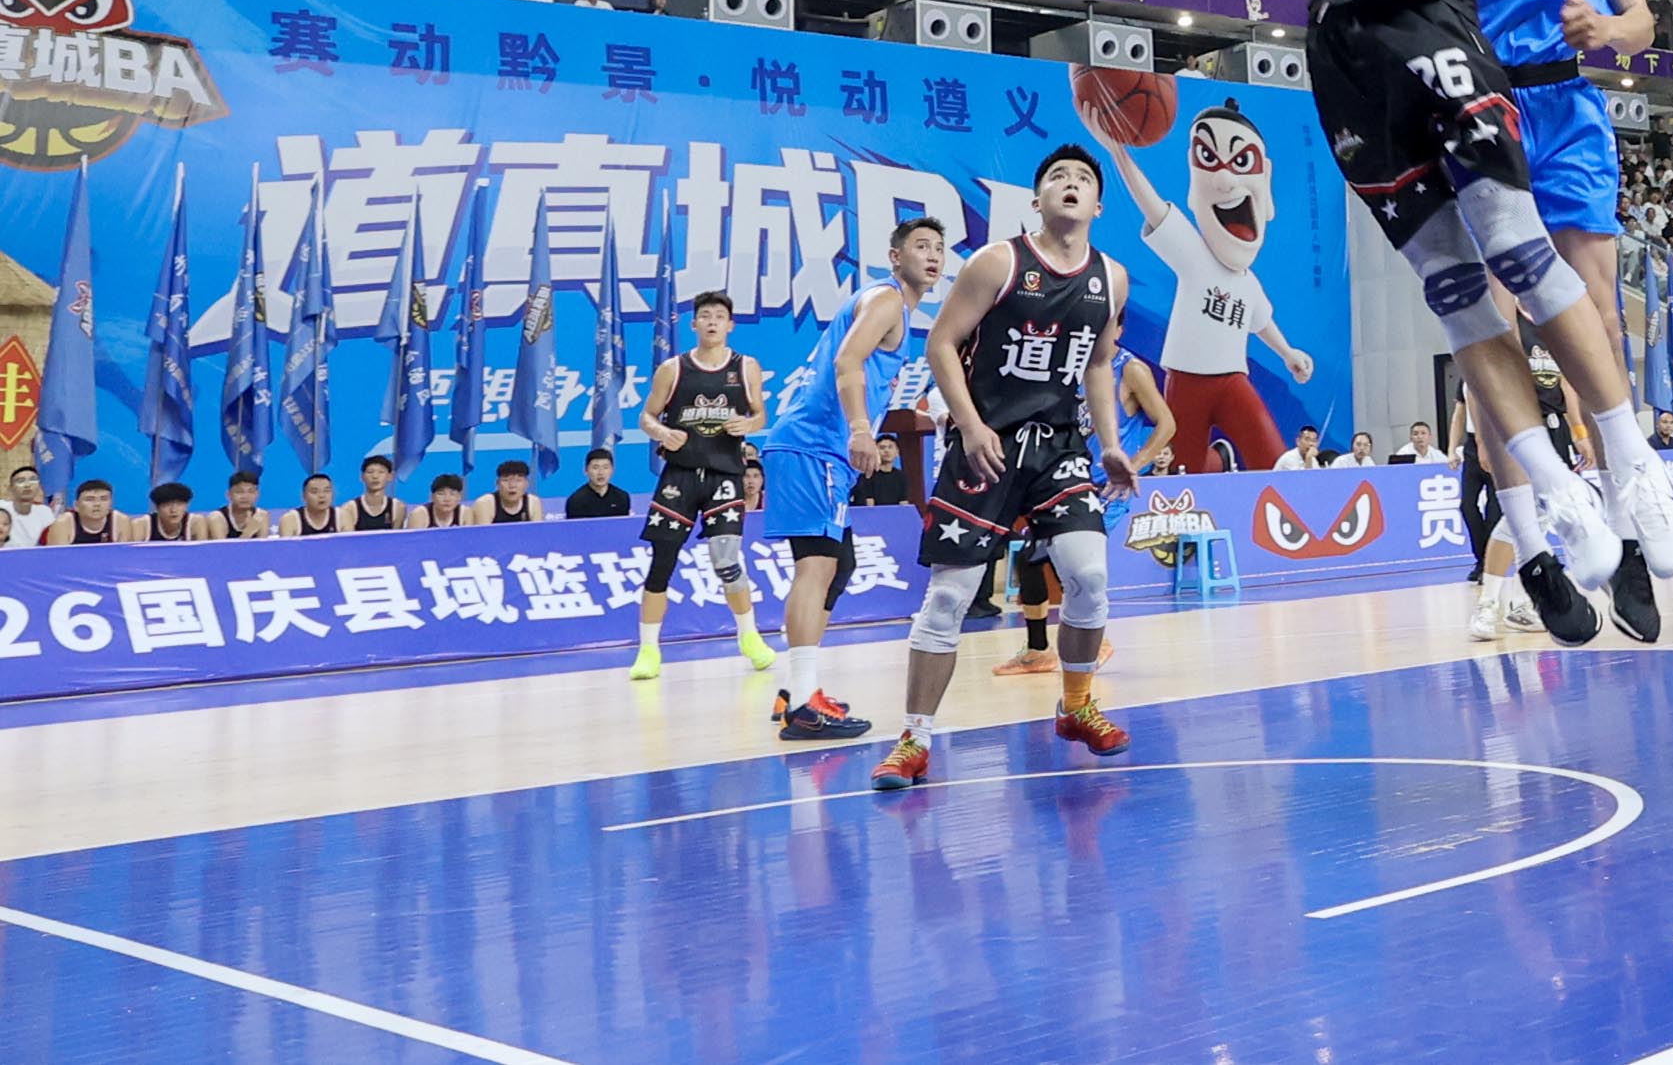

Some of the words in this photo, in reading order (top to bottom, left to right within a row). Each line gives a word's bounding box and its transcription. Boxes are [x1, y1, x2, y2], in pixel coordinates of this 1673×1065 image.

[1201, 287, 1247, 329] 道真
[999, 325, 1097, 386] 道真
[1130, 512, 1216, 536] 道真城BA
[1418, 474, 1466, 549] 贵
